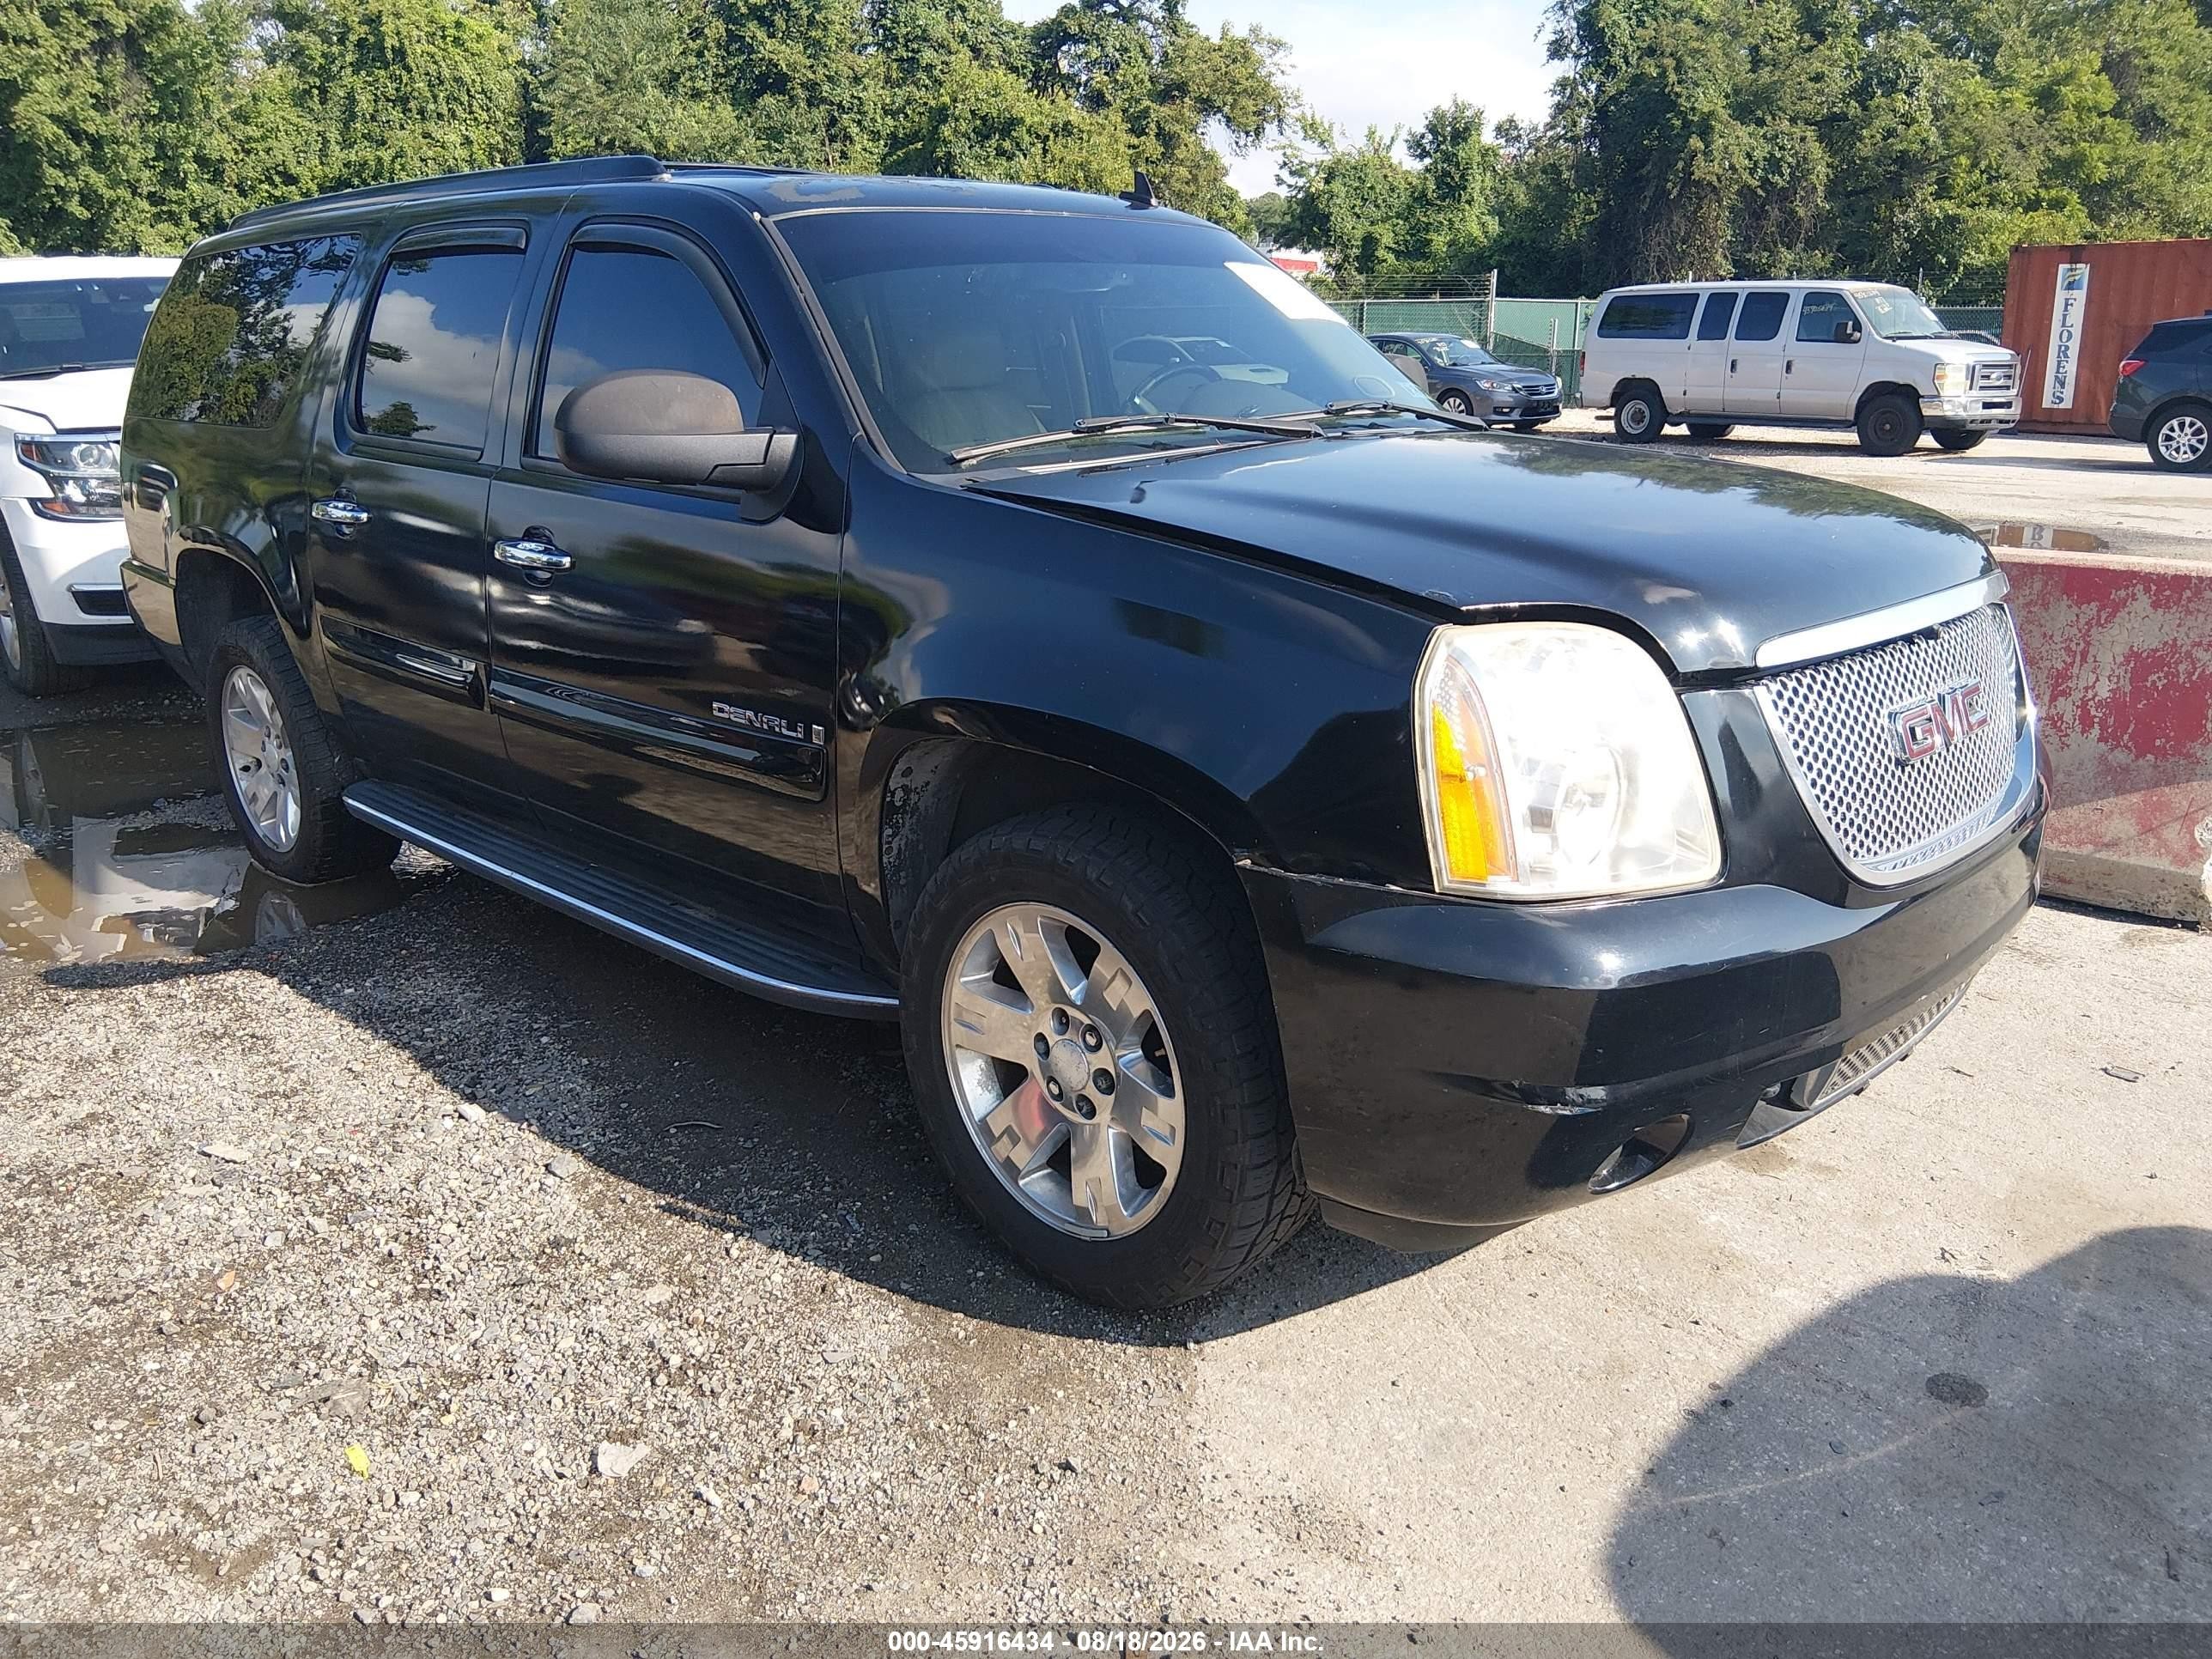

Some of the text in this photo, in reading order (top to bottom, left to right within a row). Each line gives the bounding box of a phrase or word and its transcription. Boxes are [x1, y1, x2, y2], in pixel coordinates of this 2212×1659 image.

[2051, 297, 2076, 405] FLORENS
[712, 701, 805, 739] DENALI
[1892, 679, 1990, 763] GMC
